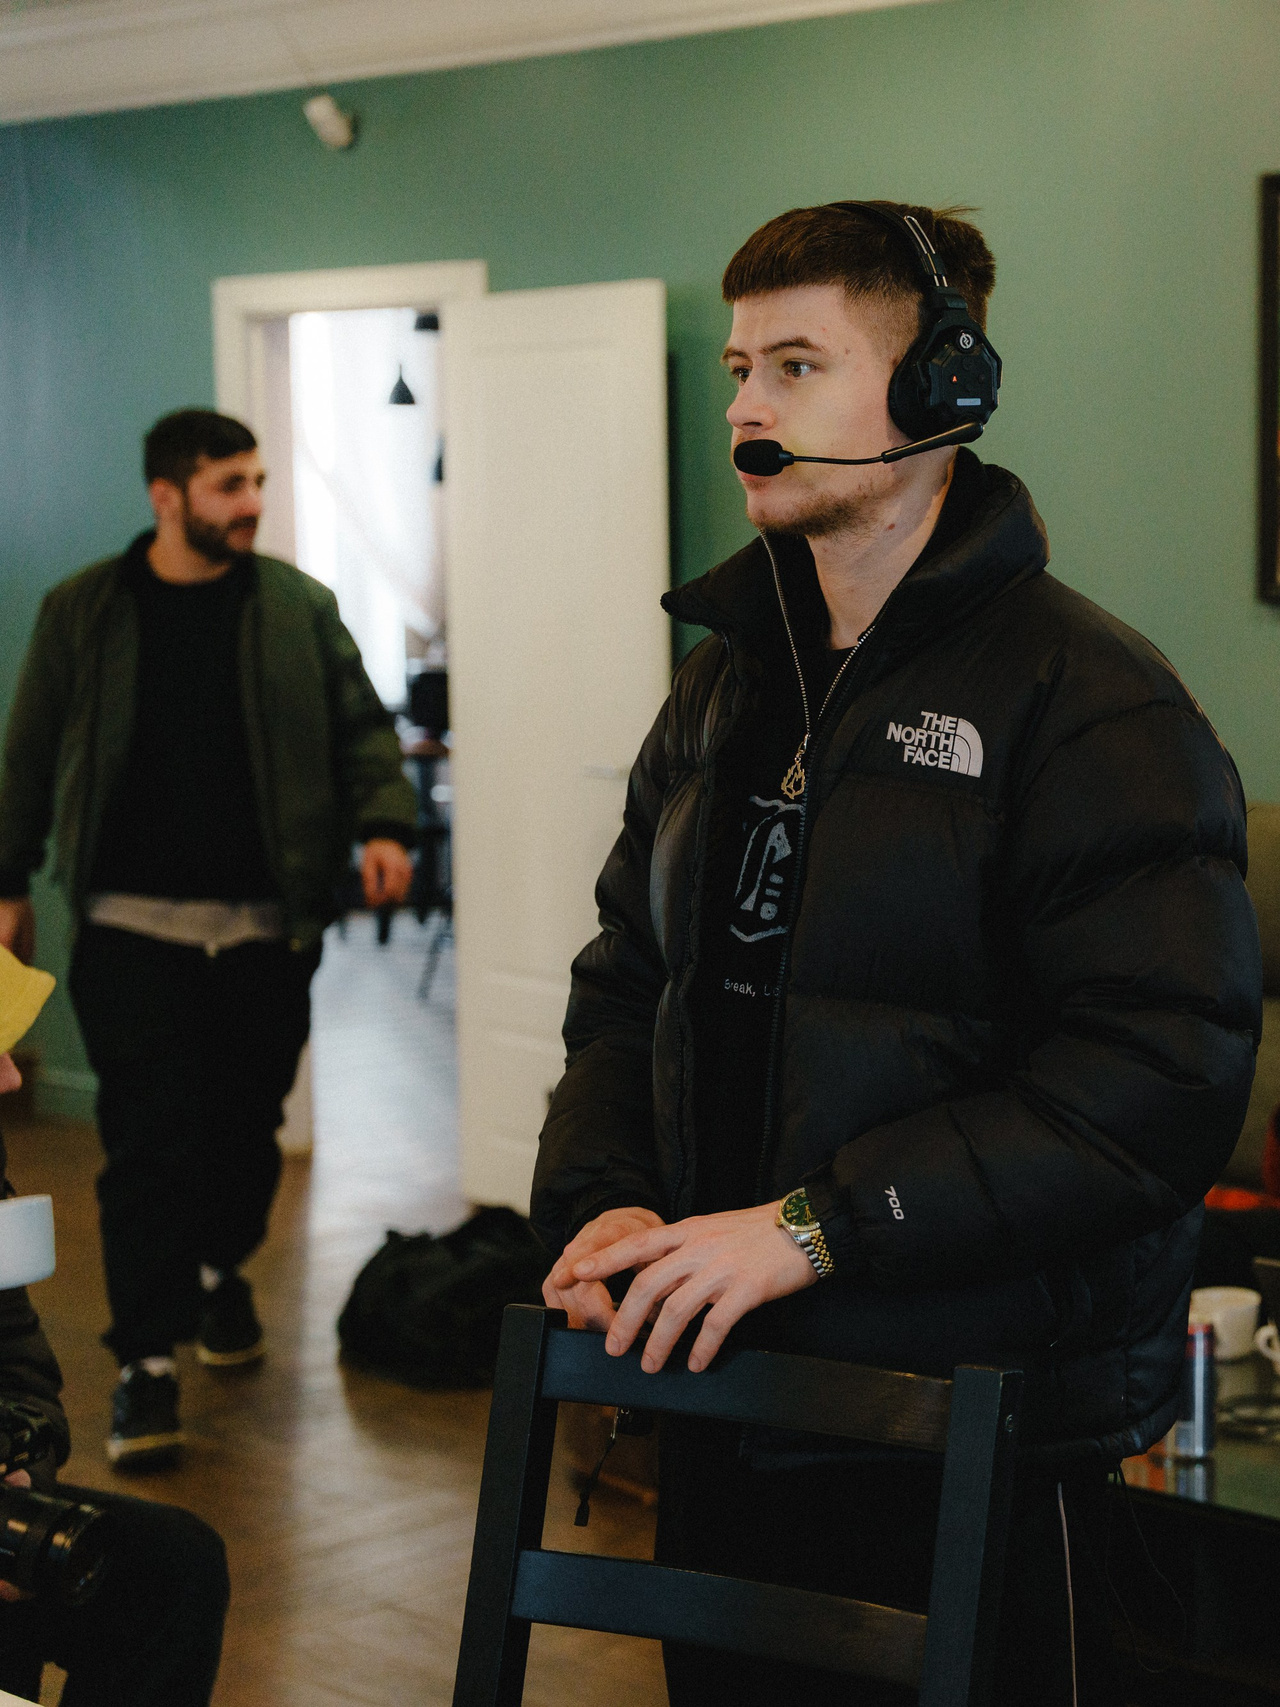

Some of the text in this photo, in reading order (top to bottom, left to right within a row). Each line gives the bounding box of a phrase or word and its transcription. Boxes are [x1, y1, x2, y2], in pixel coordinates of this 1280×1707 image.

[920, 711, 958, 734] THE
[886, 721, 954, 753] NORTH
[903, 745, 952, 770] FACE
[884, 1185, 905, 1220] 700
